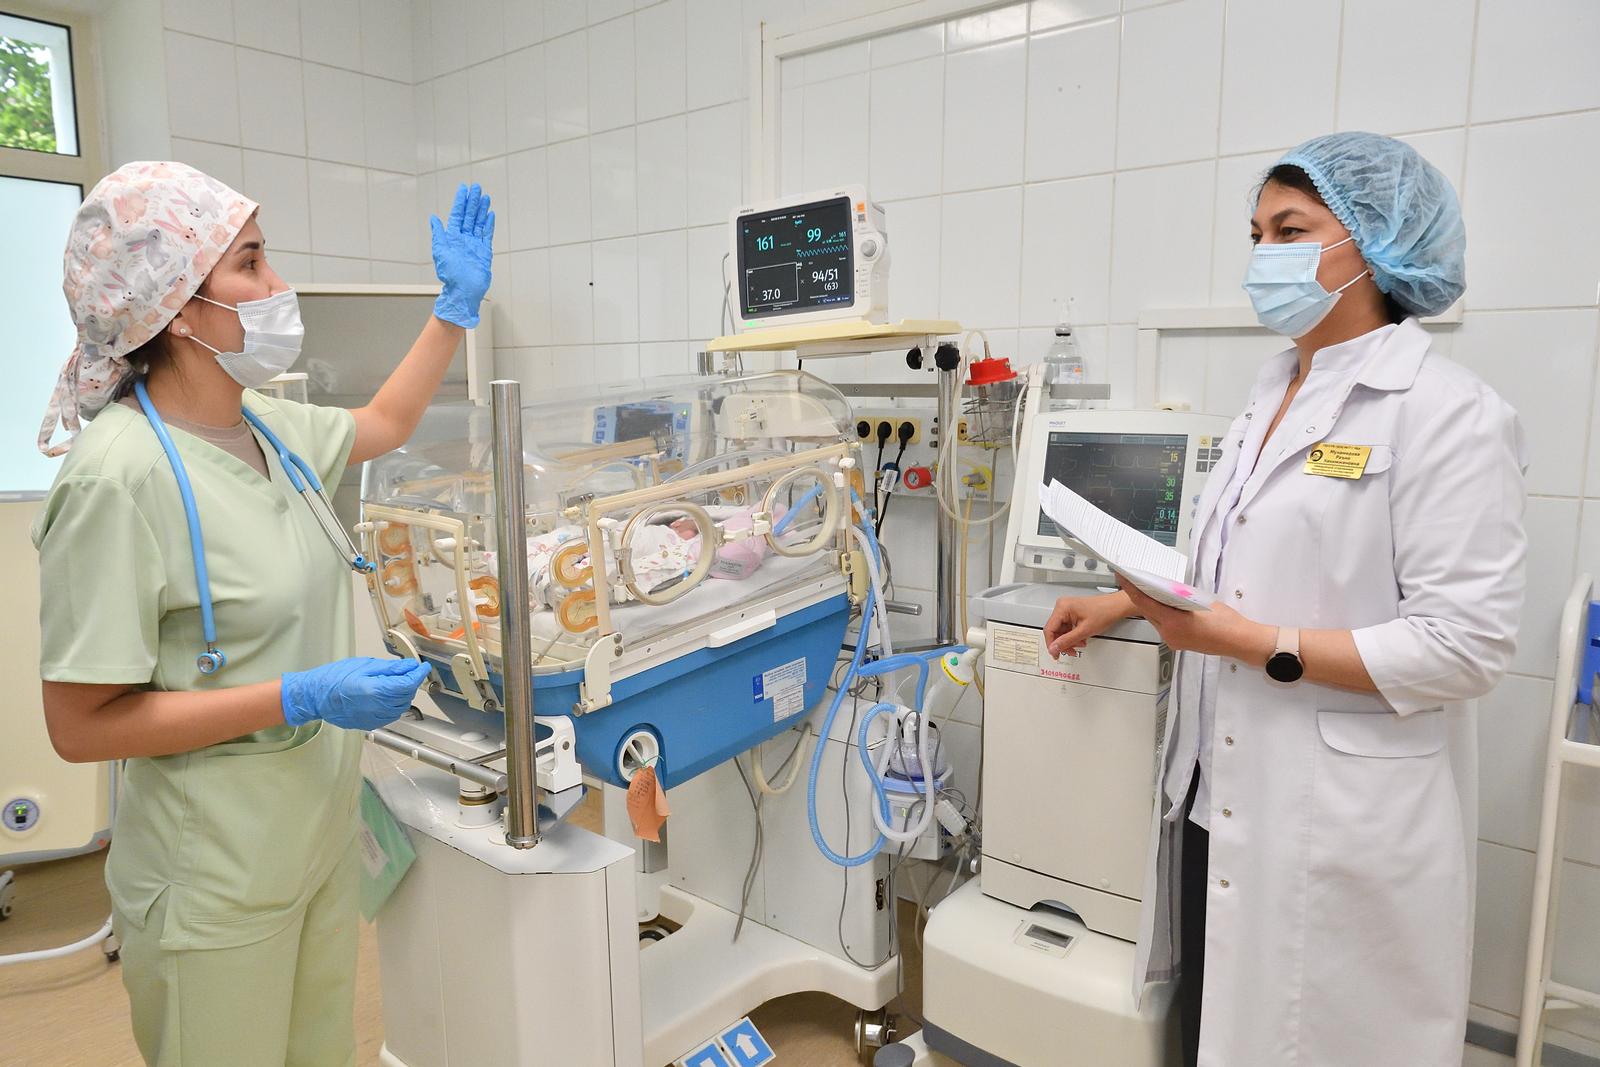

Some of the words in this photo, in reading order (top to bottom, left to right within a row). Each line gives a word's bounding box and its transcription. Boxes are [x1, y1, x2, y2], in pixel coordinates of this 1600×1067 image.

[806, 227, 822, 243] 99
[756, 236, 774, 251] 161
[811, 268, 839, 283] 94/51
[824, 282, 839, 292] (63)
[762, 288, 781, 301] 37.0
[1170, 453, 1178, 462] 15
[1166, 477, 1176, 487] 30
[1164, 491, 1174, 501] 35
[1159, 509, 1176, 519] 0.14
